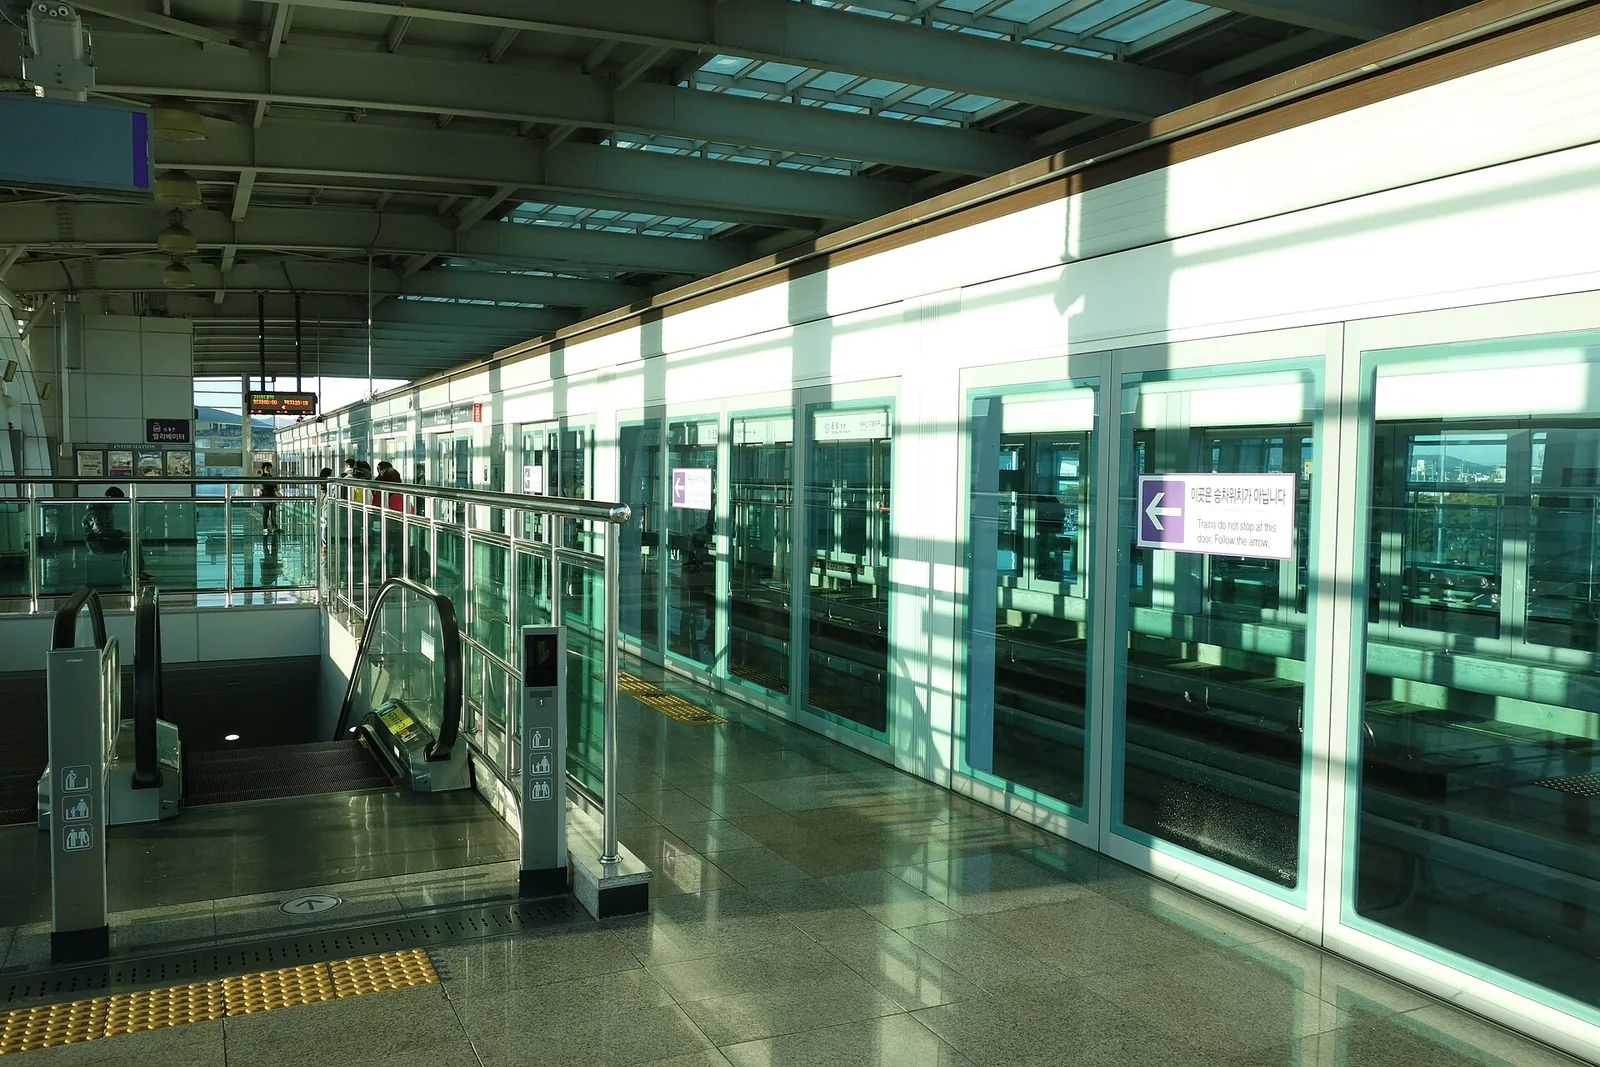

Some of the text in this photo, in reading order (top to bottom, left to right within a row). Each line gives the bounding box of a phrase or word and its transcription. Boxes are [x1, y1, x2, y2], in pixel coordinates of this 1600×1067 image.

[152, 432, 185, 440] 엘리베이터
[1191, 487, 1286, 505] 이곳은 승차위치가 아닙니다
[1198, 519, 1277, 533] Trains do not stop at this
[1214, 535, 1235, 546] Follow
[1237, 536, 1247, 547] the
